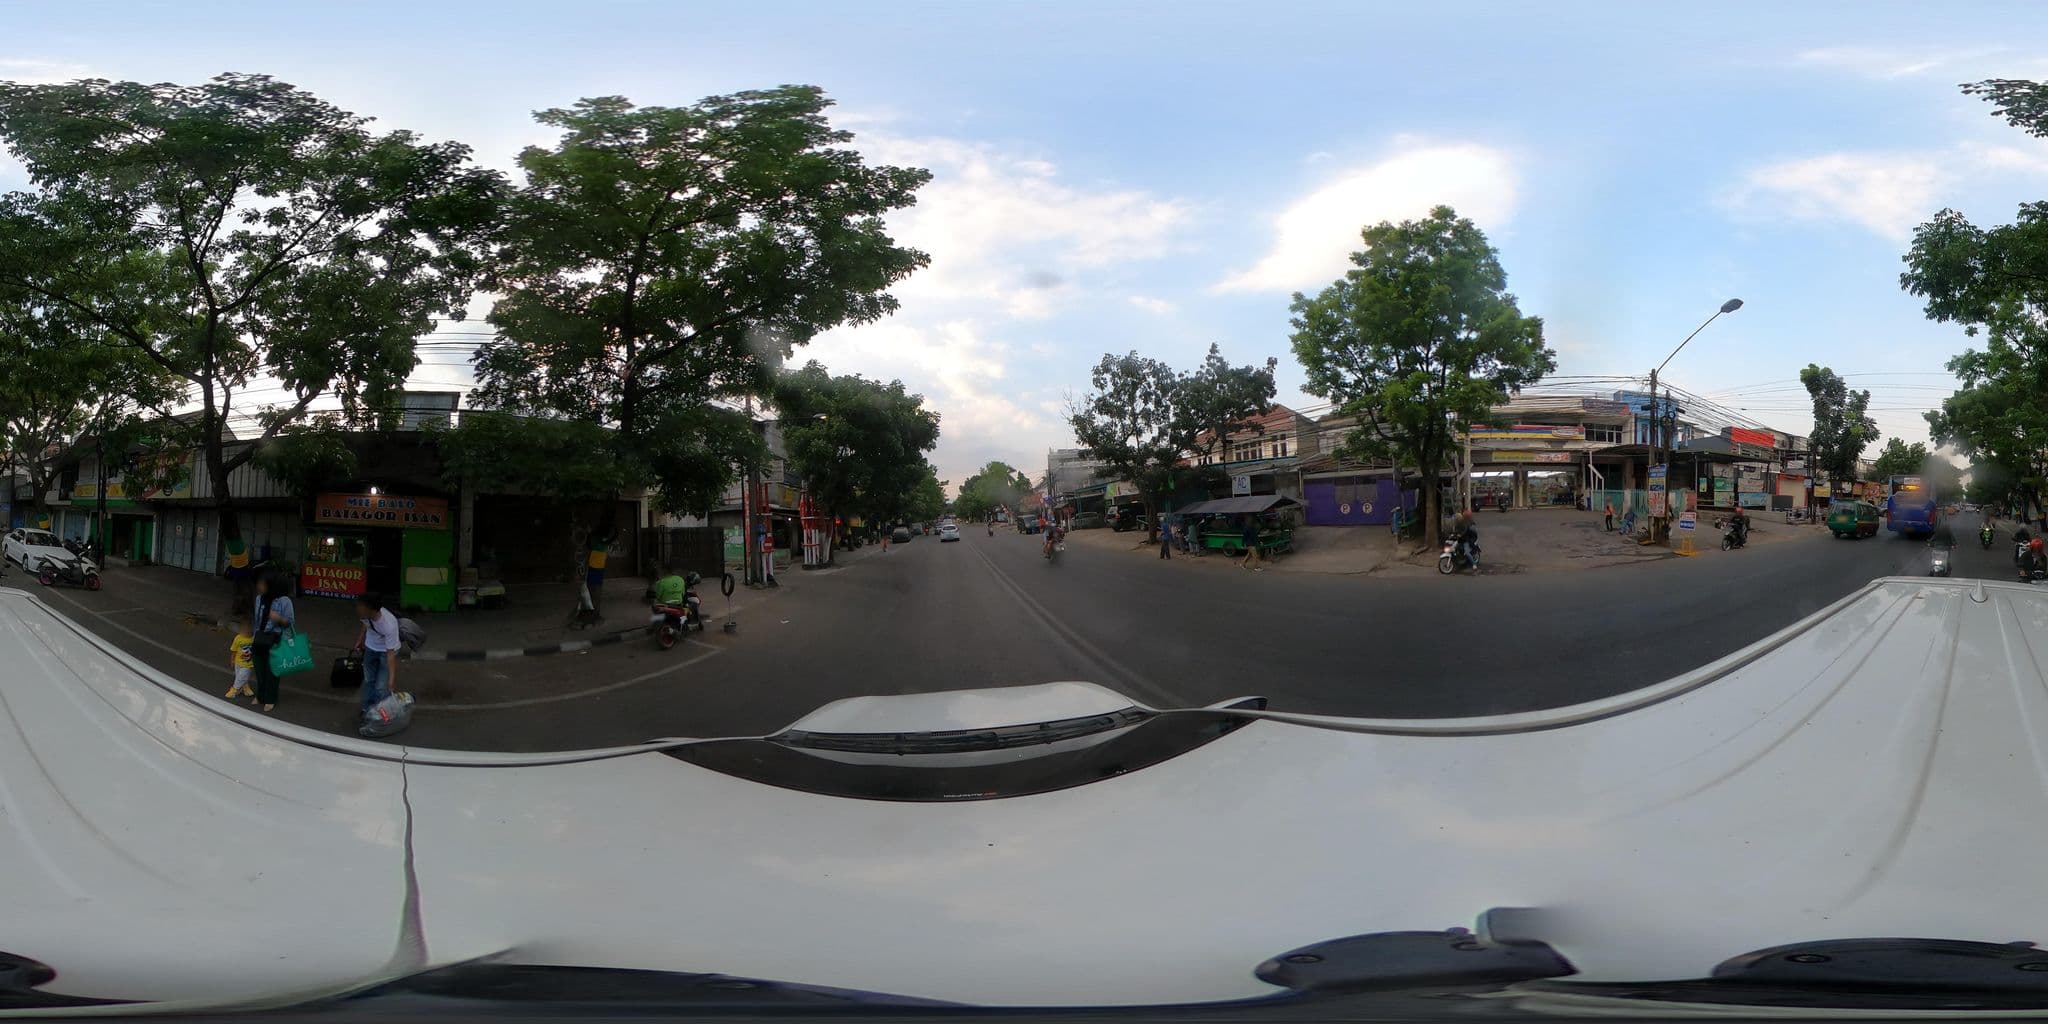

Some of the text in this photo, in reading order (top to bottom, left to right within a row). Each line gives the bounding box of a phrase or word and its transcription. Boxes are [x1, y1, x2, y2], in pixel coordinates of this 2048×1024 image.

[321, 509, 441, 524] BATAGOR ISAN
[305, 566, 362, 581] BATAGOR
[318, 578, 347, 591] ISAN
[280, 656, 312, 669] hello
